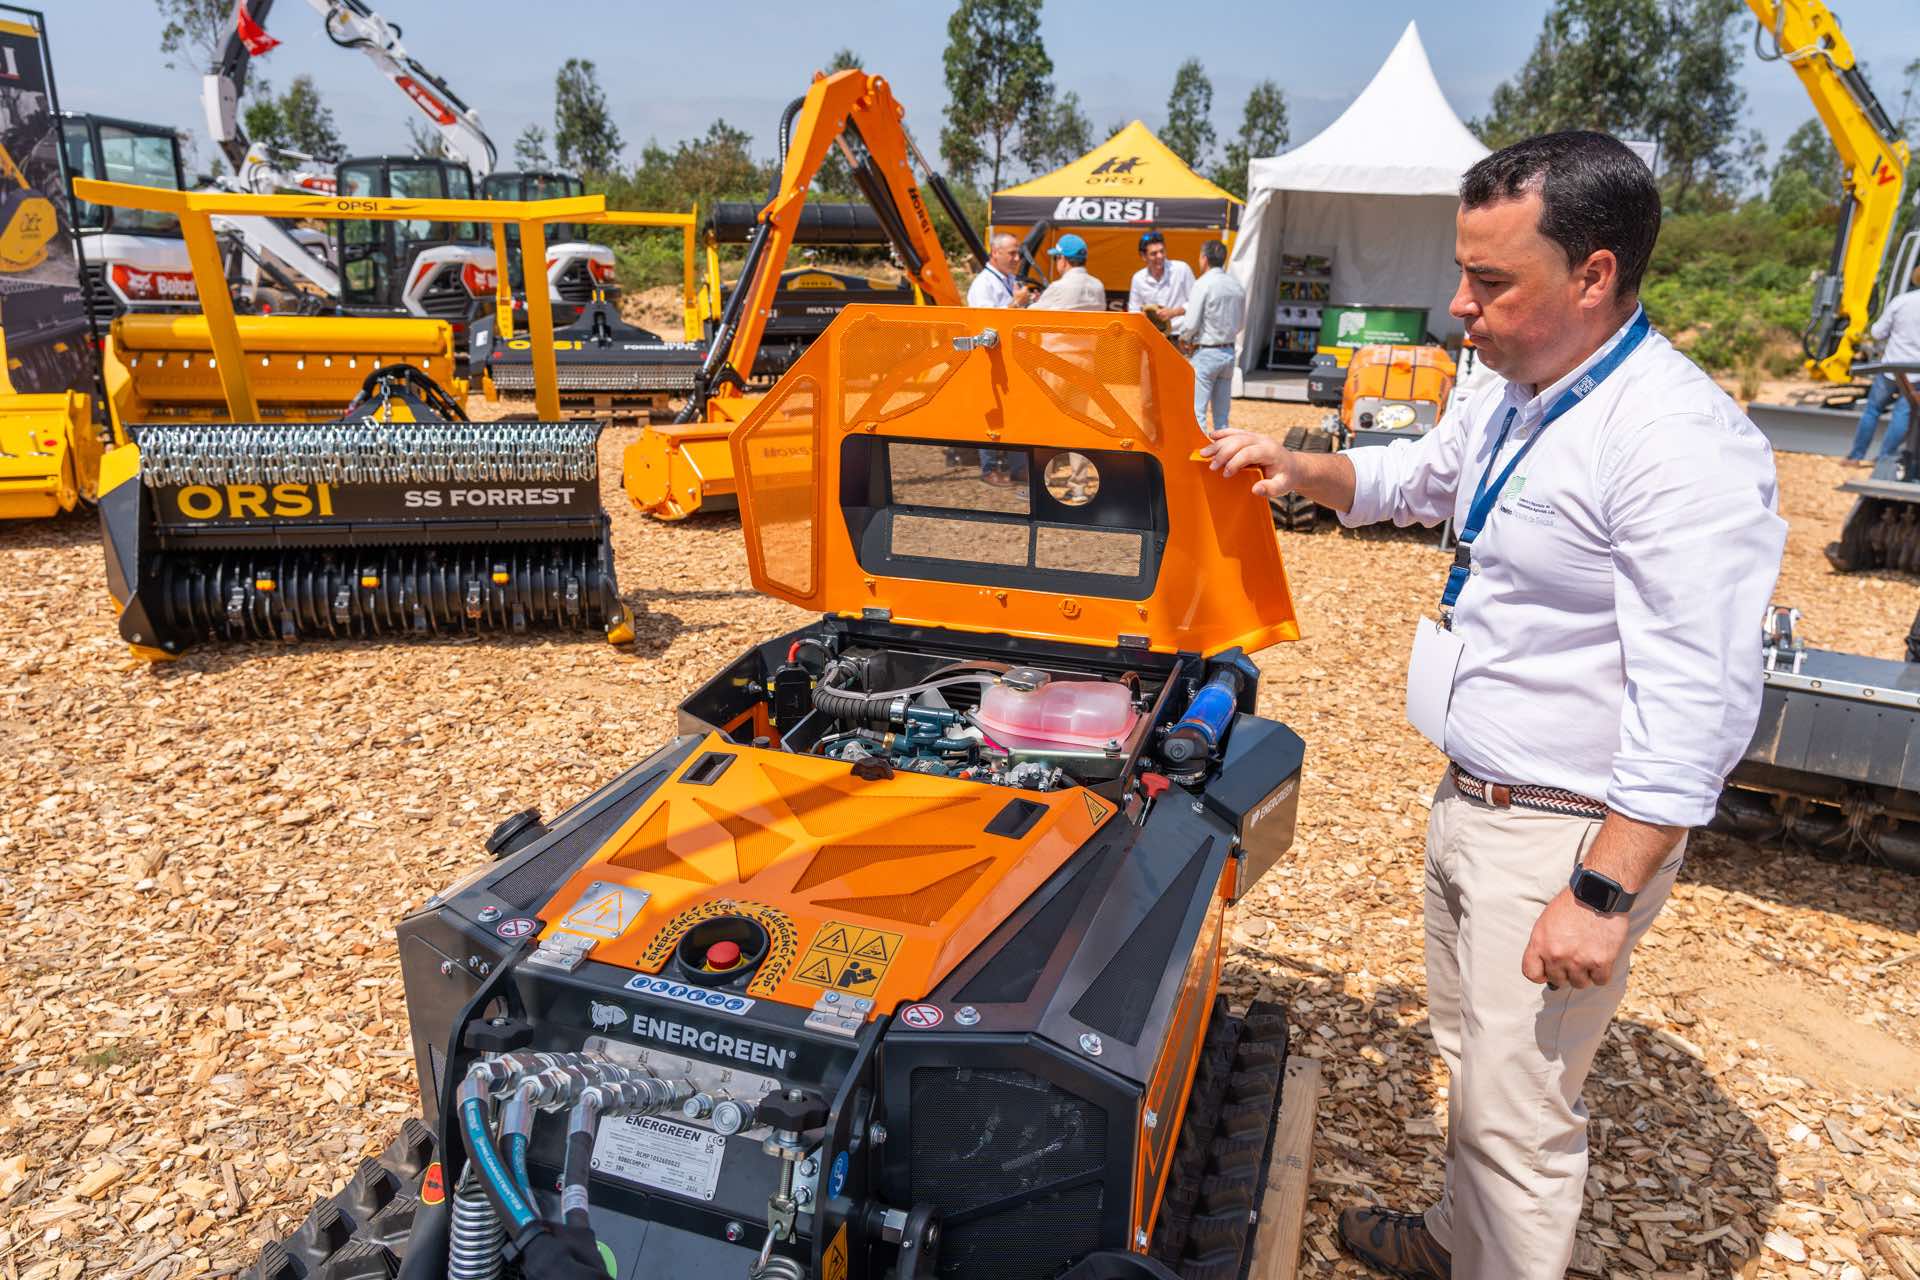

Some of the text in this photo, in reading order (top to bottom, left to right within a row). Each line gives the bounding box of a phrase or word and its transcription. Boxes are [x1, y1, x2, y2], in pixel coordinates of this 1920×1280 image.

[1086, 177, 1145, 185] ORSI
[337, 200, 379, 212] ORSI
[177, 483, 335, 519] ORSI
[404, 487, 576, 508] SS FORREST
[647, 902, 736, 961] EMERGENCY STOP
[759, 909, 791, 988] EMERGENCY STOP
[624, 1115, 702, 1142] ENERGREEN
